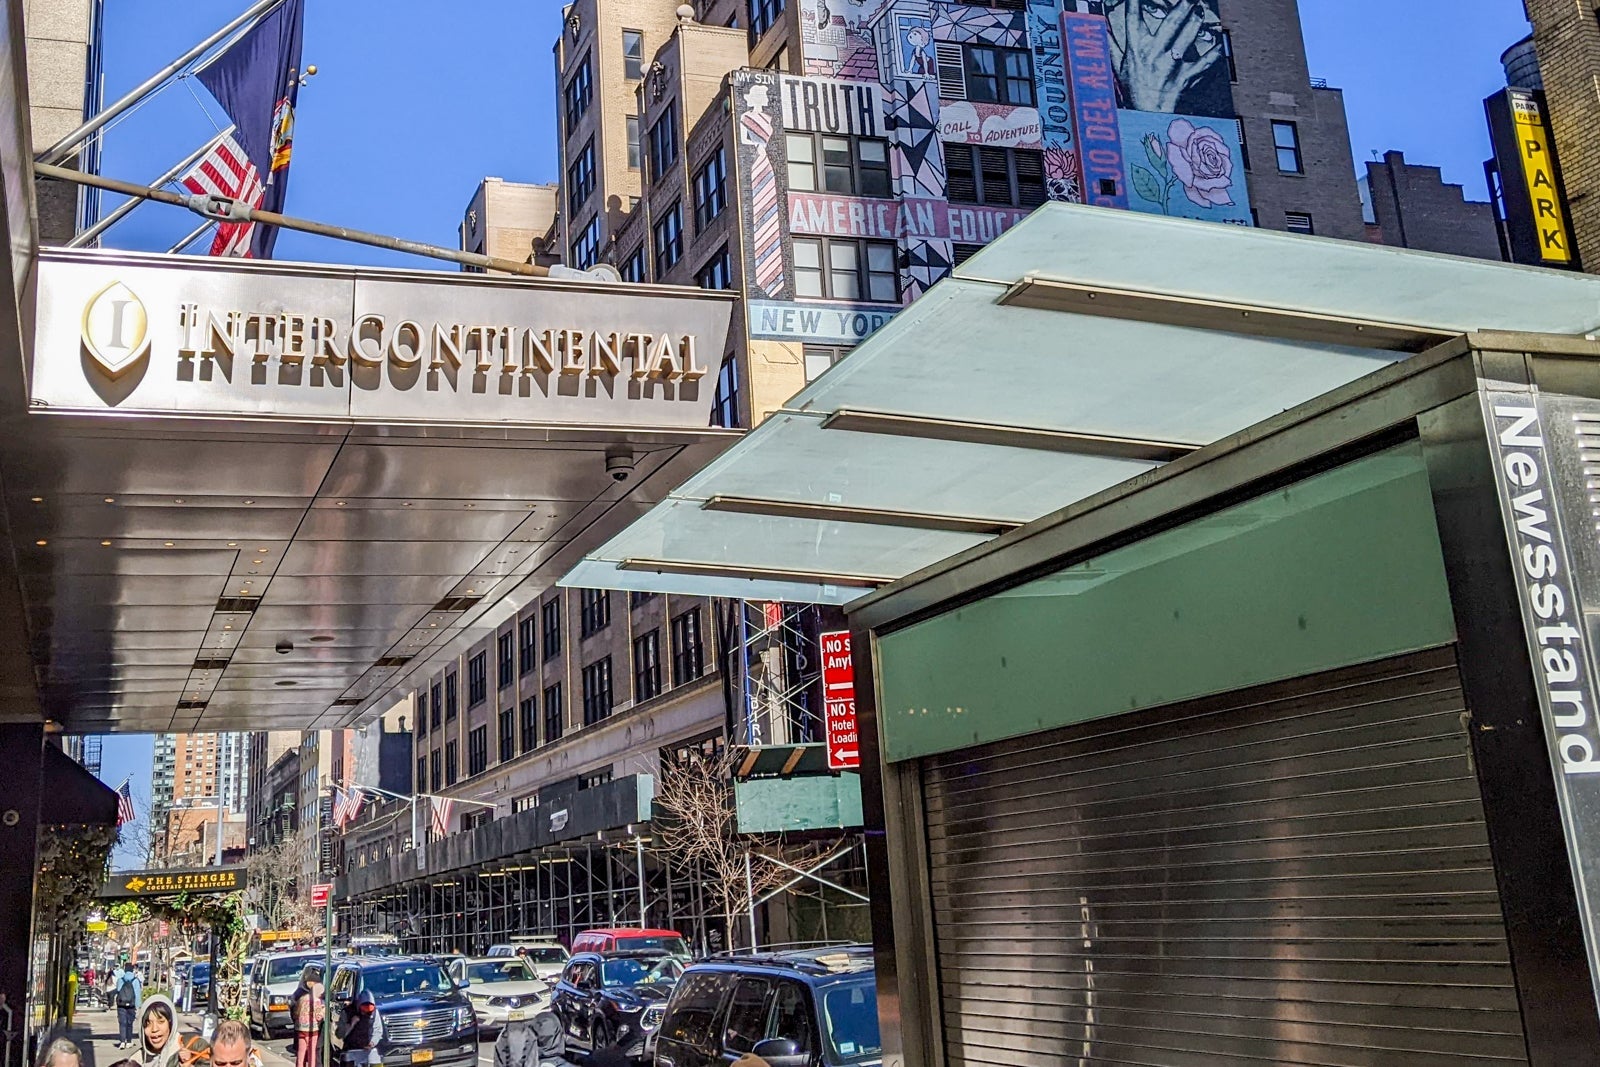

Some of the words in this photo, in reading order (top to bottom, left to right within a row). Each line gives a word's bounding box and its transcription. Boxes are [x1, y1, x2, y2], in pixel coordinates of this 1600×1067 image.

[735, 71, 751, 82] MY
[754, 73, 775, 85] SIN
[1037, 15, 1071, 144] JOURNEY
[785, 78, 876, 136] TRUTH
[1514, 102, 1537, 112] PARK
[1518, 113, 1538, 122] FAST
[943, 121, 972, 135] CALL
[985, 123, 1039, 143] ADVENTURE
[1525, 139, 1564, 250] PARK
[790, 198, 936, 238] AMERICAN
[951, 208, 1028, 242] EDUC
[761, 308, 822, 334] NEW
[837, 312, 894, 337] YOR
[180, 303, 708, 382] INTERCONTINENTAL
[1494, 404, 1600, 774] Newsstand
[826, 640, 842, 653] NO
[830, 703, 846, 716] NO
[831, 719, 855, 731] Hotel
[146, 877, 173, 885] THE
[177, 873, 235, 884] STINGER
